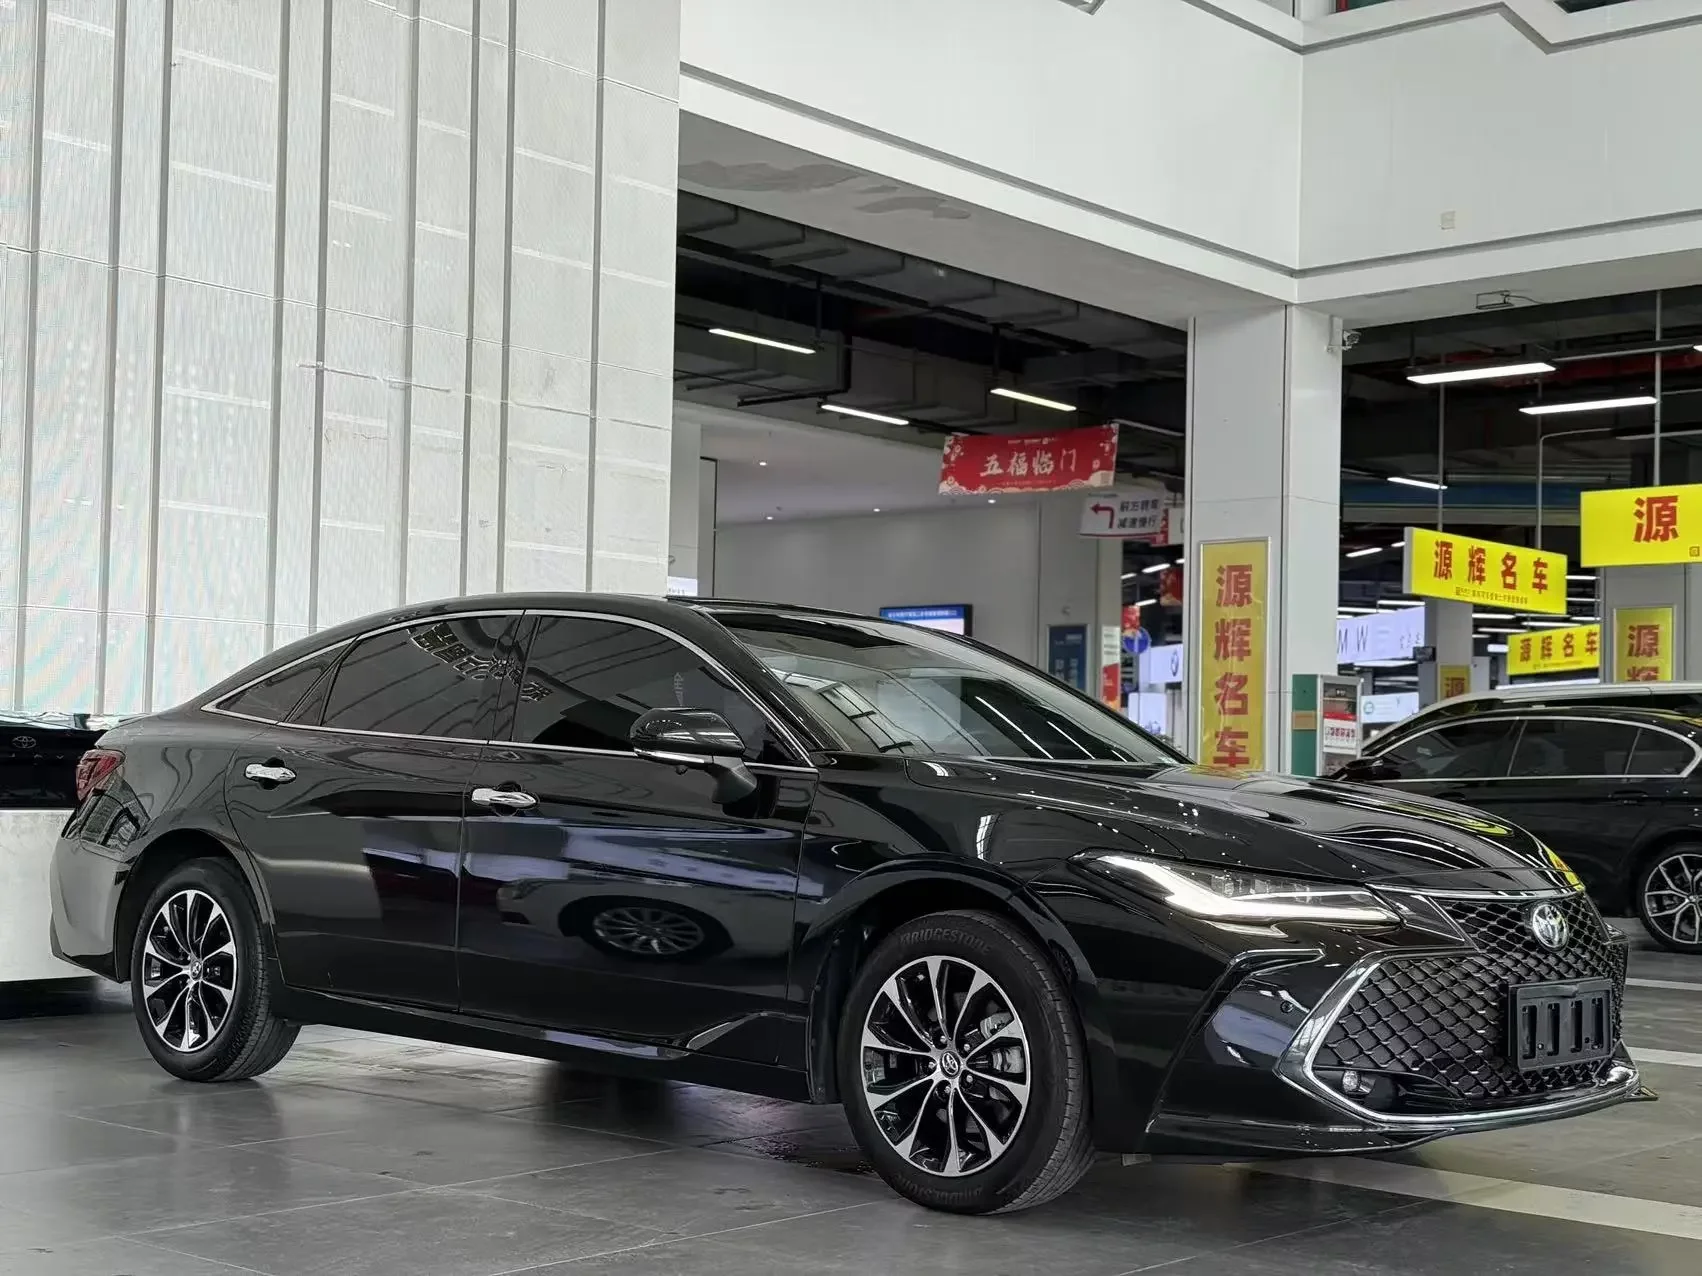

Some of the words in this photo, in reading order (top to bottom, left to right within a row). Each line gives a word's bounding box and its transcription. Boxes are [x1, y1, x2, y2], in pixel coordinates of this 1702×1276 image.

[979, 448, 1076, 477] 五福临门
[1633, 495, 1680, 543] 源
[1433, 539, 1549, 595] 源辉名车
[1213, 563, 1253, 768] 源辉名车
[1519, 629, 1598, 663] 源辉名车
[900, 927, 993, 956] BRIDGESTONE
